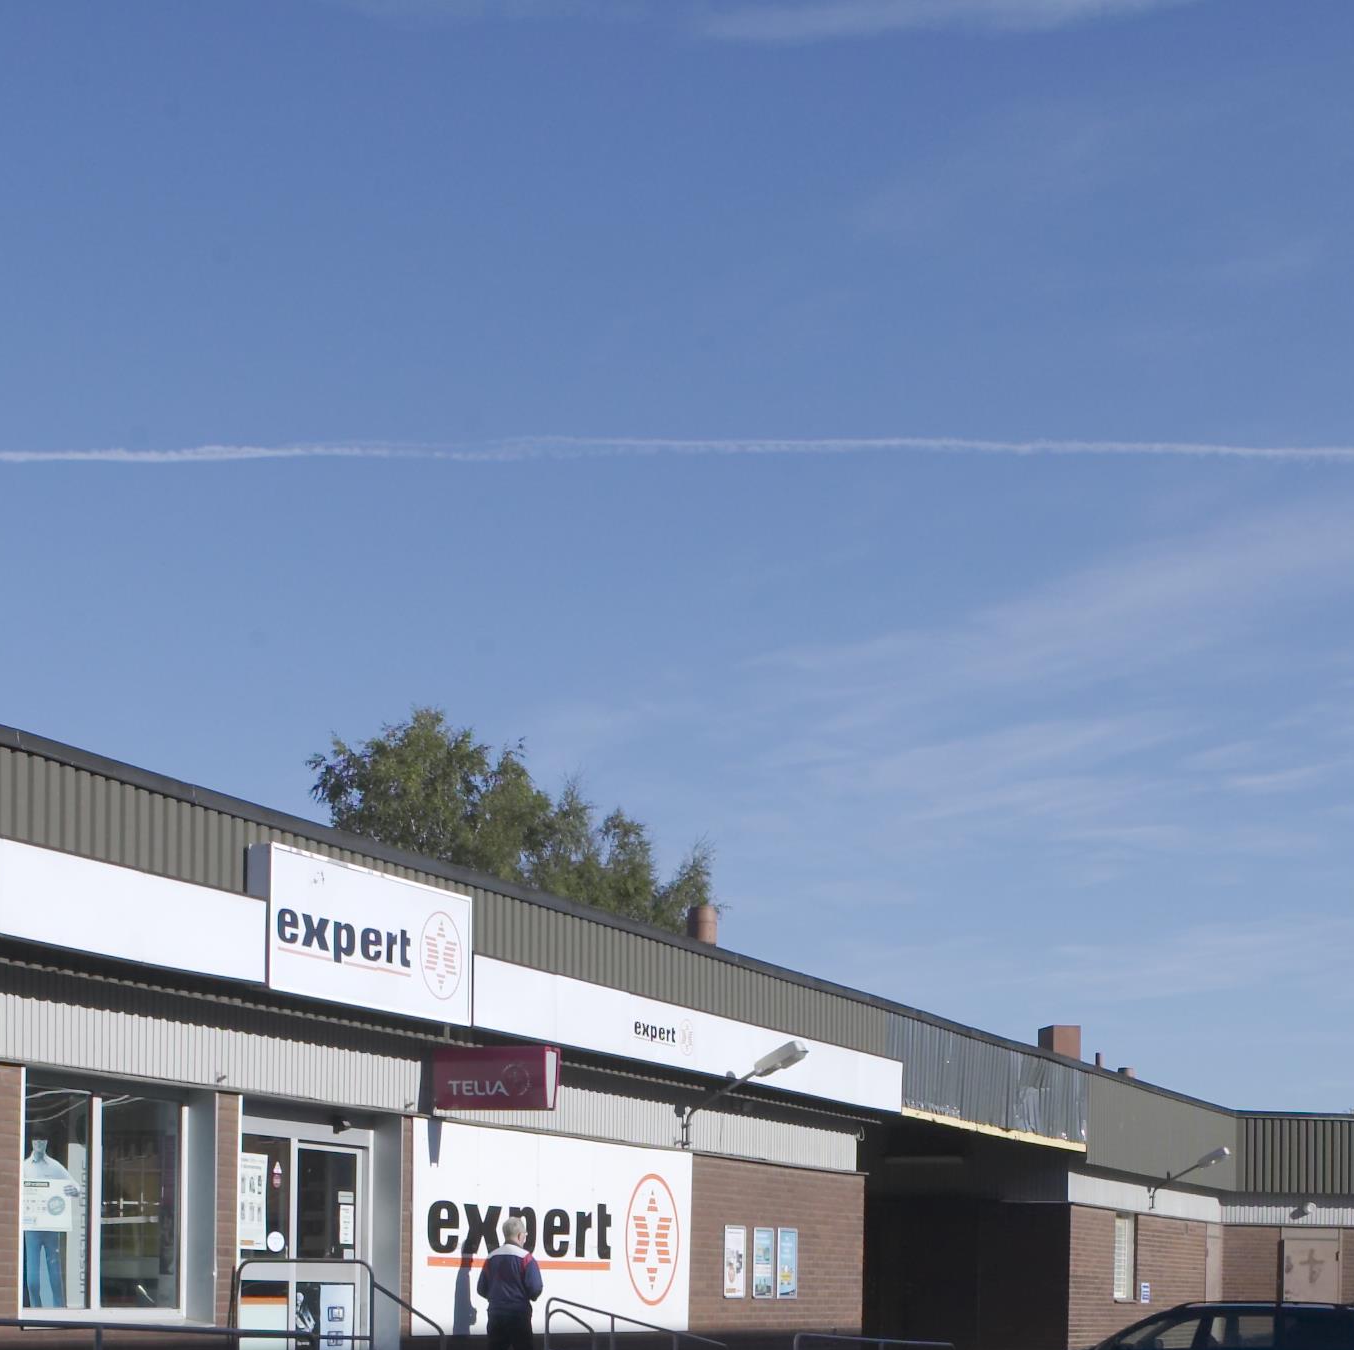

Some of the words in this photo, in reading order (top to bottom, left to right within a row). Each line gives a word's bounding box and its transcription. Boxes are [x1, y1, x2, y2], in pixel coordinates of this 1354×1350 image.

[277, 907, 411, 966] expert
[634, 1021, 676, 1043] expert
[447, 1080, 510, 1096] TELIA
